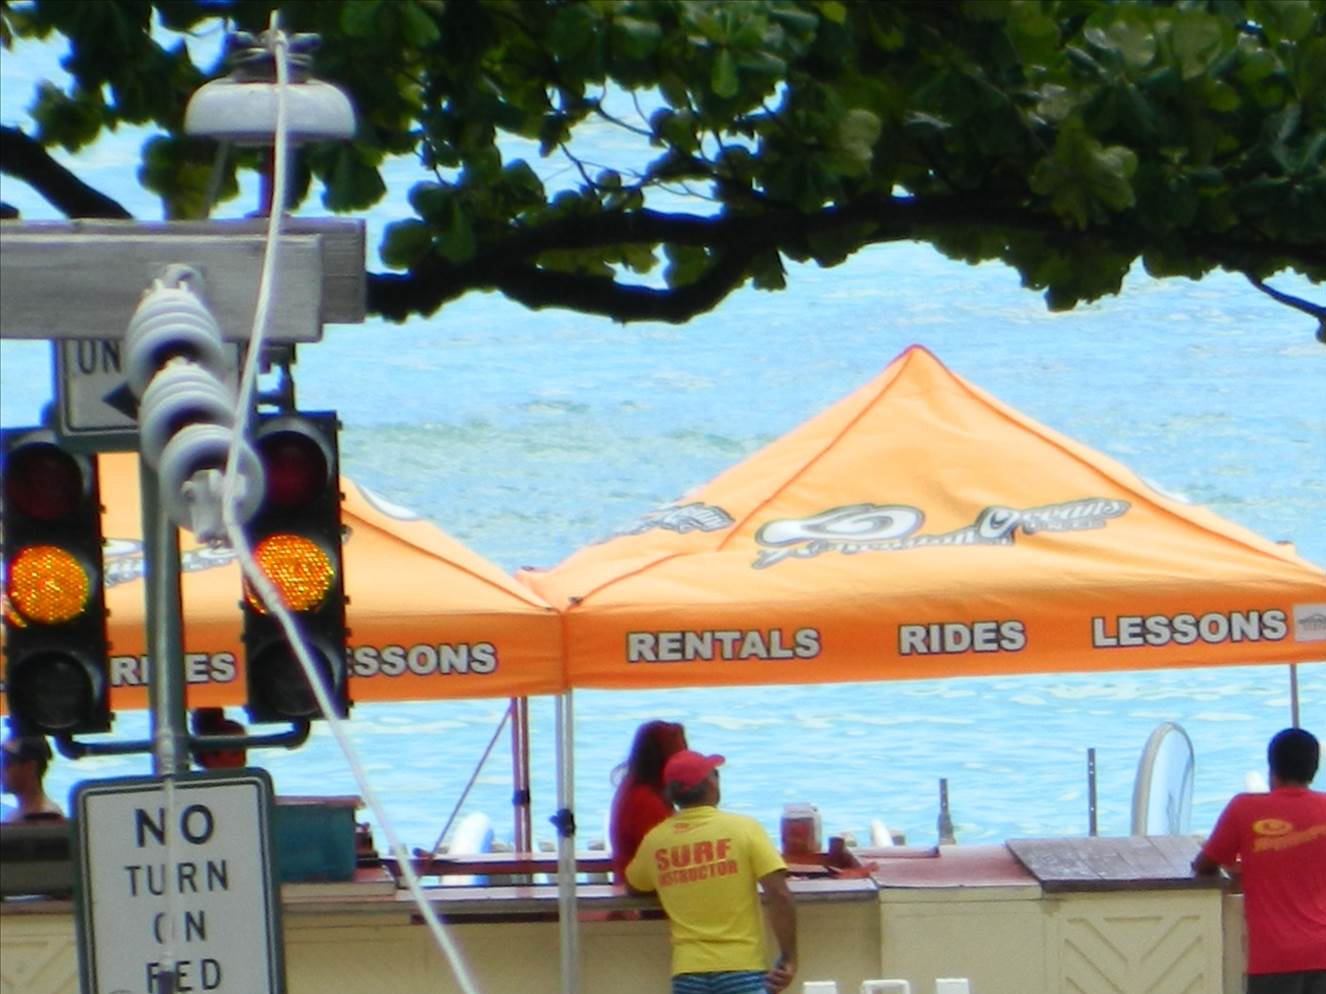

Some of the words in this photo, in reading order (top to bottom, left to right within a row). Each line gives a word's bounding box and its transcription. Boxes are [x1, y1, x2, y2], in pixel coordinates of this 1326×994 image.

[626, 629, 820, 662] RENTALS
[899, 620, 1026, 655] RIDES
[1092, 608, 1289, 648] LESSONS
[135, 803, 214, 848] NO
[655, 838, 731, 871] SURF
[125, 860, 229, 897] TURN
